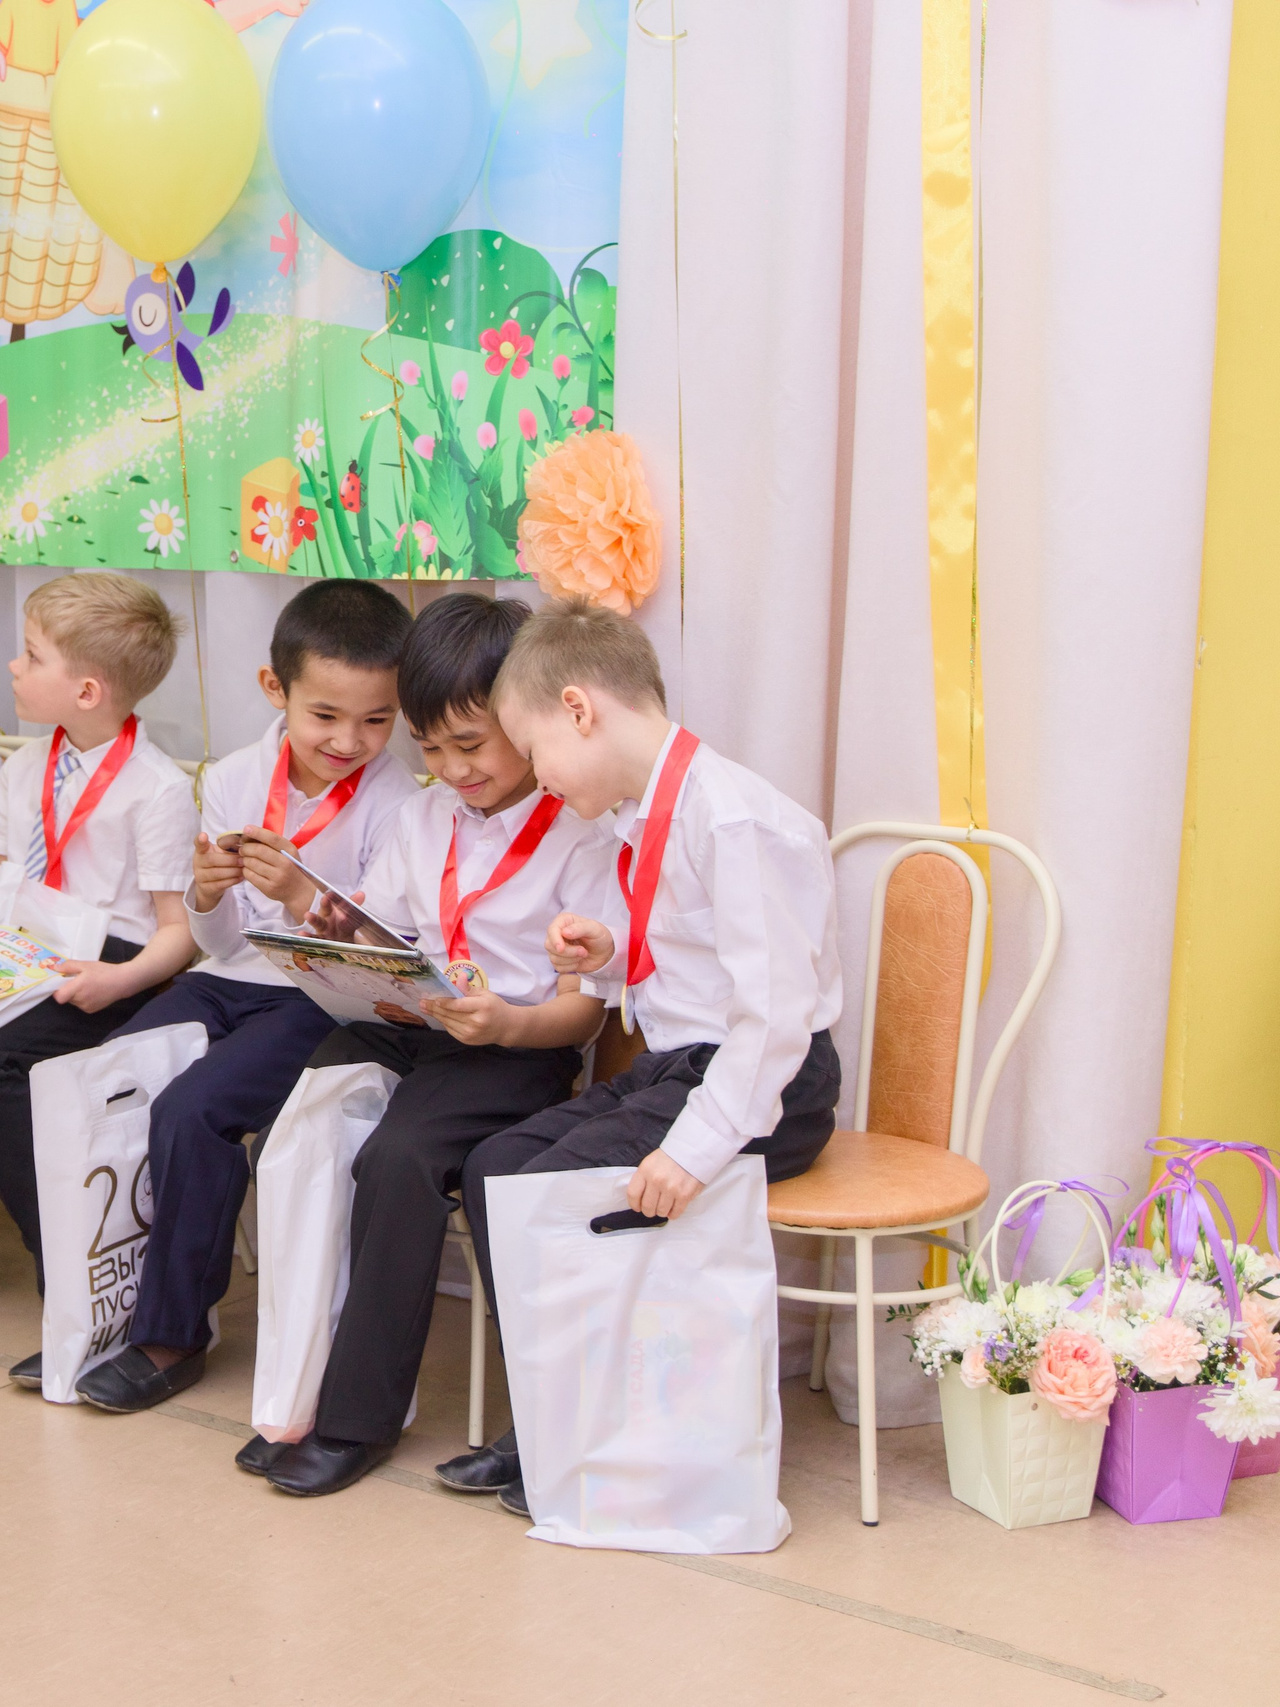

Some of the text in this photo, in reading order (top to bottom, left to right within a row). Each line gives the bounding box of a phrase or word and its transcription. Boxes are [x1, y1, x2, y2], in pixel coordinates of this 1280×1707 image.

[87, 1247, 136, 1296] ВЫ
[90, 1281, 139, 1328] ПУС
[85, 1314, 134, 1361] НИ
